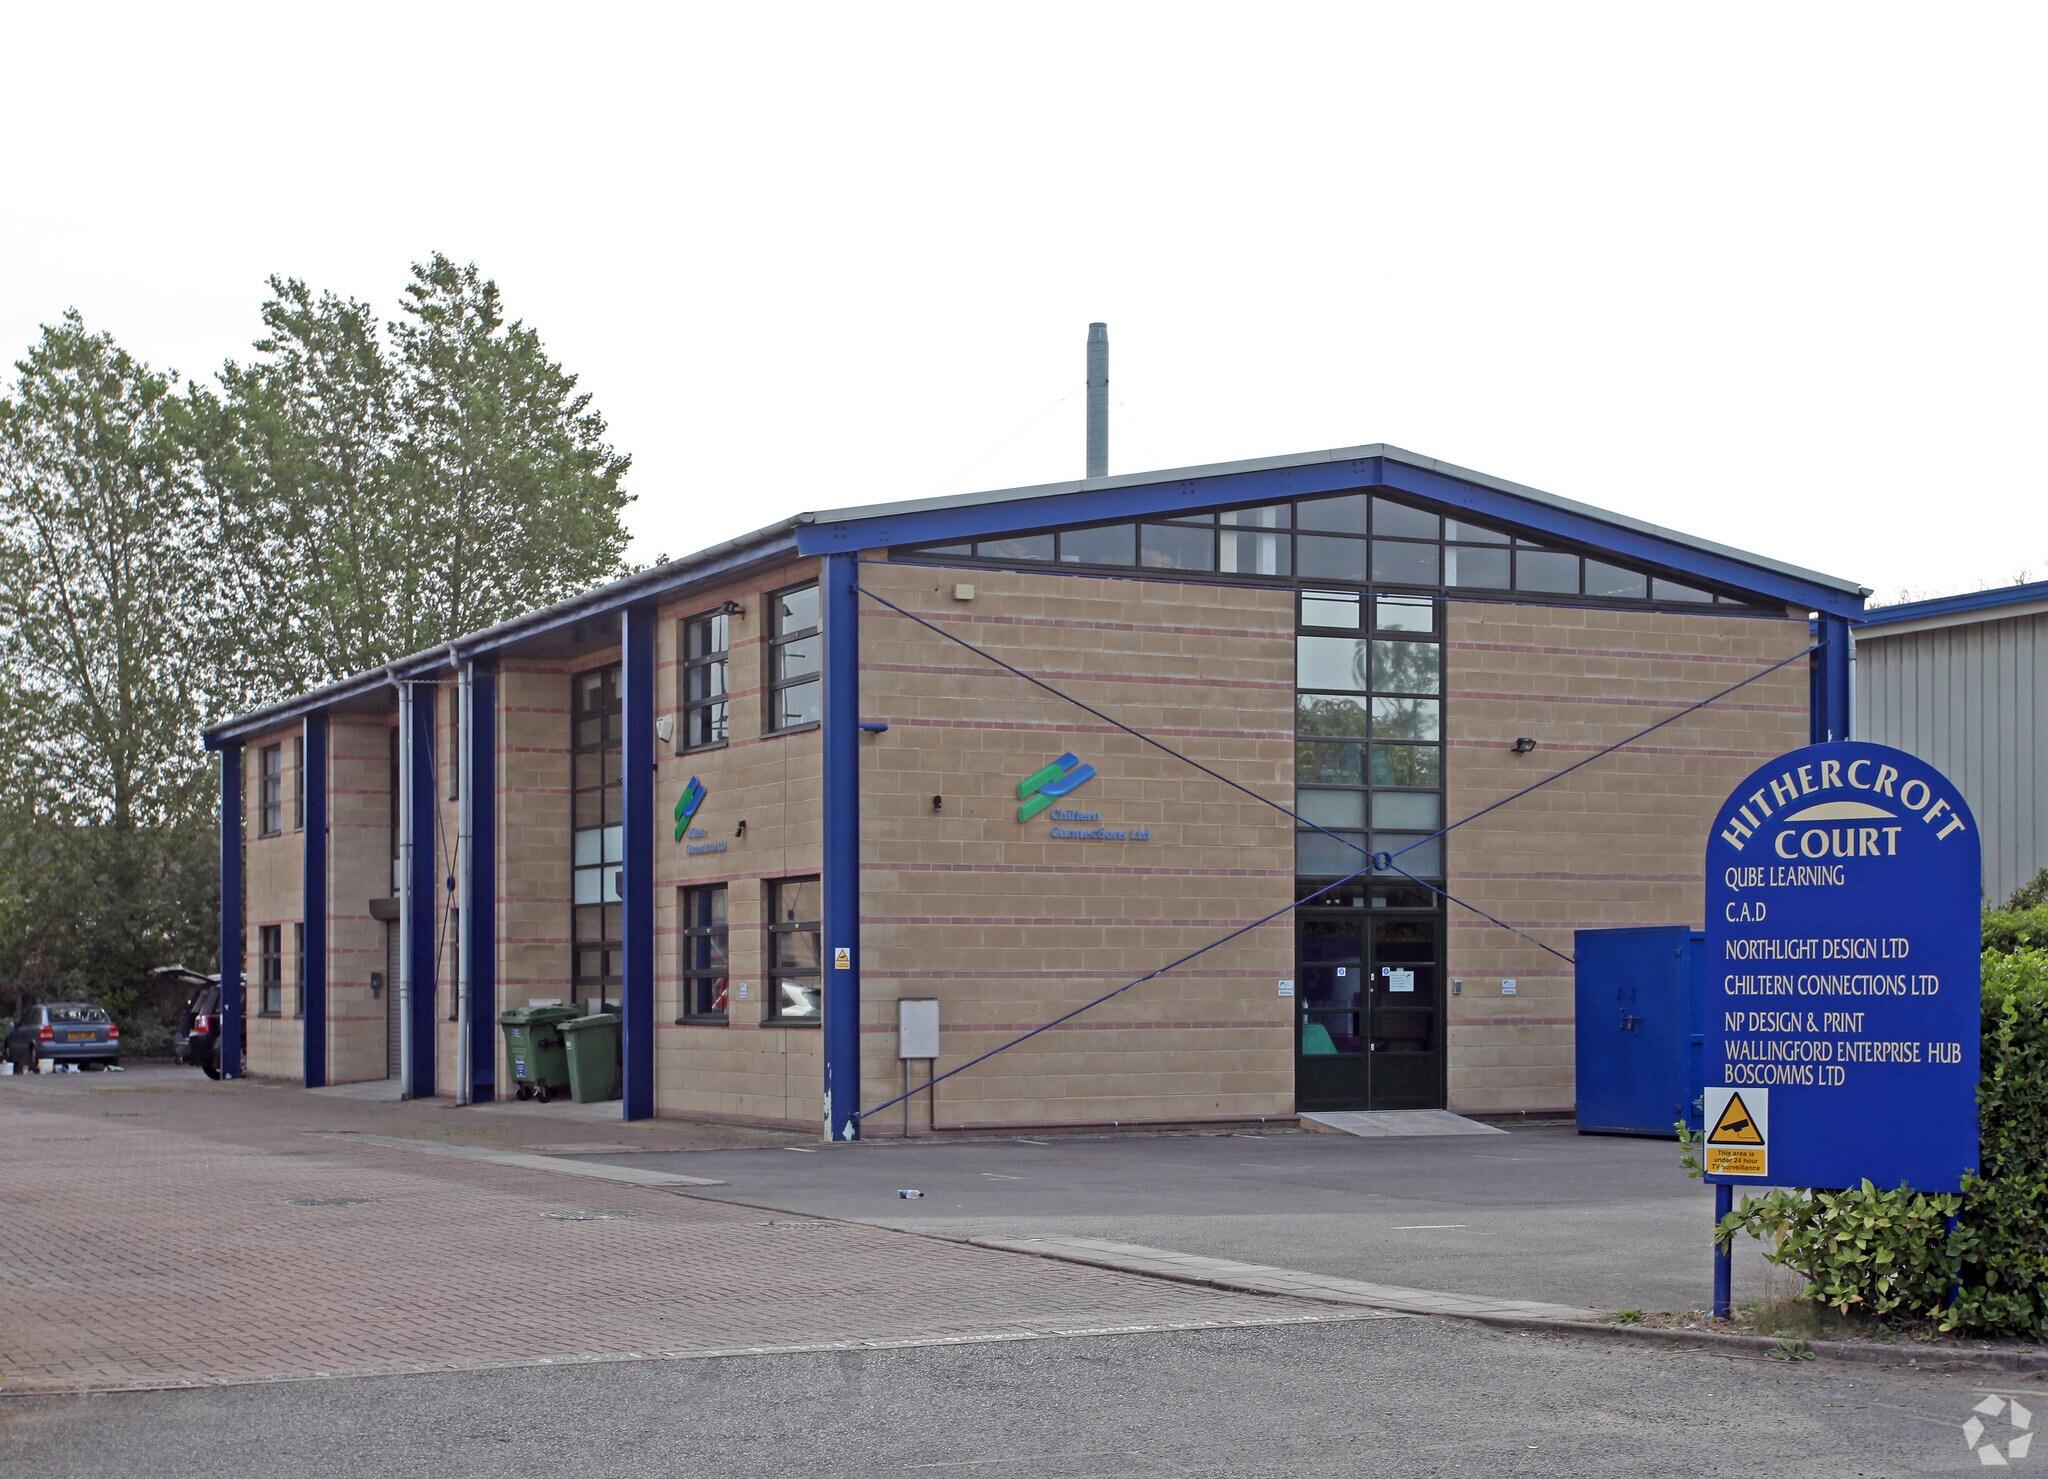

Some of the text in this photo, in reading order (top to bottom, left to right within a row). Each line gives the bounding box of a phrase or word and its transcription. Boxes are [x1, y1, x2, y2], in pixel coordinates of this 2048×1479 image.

[1050, 807, 1101, 820] Chiltern
[1721, 759, 1966, 852] HITHERCROFT
[1051, 826, 1151, 840] Connections Ltd
[1775, 826, 1902, 859] COURT
[1725, 865, 1845, 892] QUBE LEARNING
[1725, 902, 1767, 922] C.A.D
[1725, 938, 1910, 960] NORTHLIGHT DESIGN LTD
[1724, 975, 1939, 996] CHILTERN CONNECTIONS LTD
[1725, 1012, 1865, 1033] NP DESIGN & PRINT
[1725, 1040, 1962, 1064] WALLINGFORD ENTERPRISE HUB
[1724, 1063, 1845, 1086] BOSCOMMS LTD
[1721, 1163, 1761, 1171] surveillance
